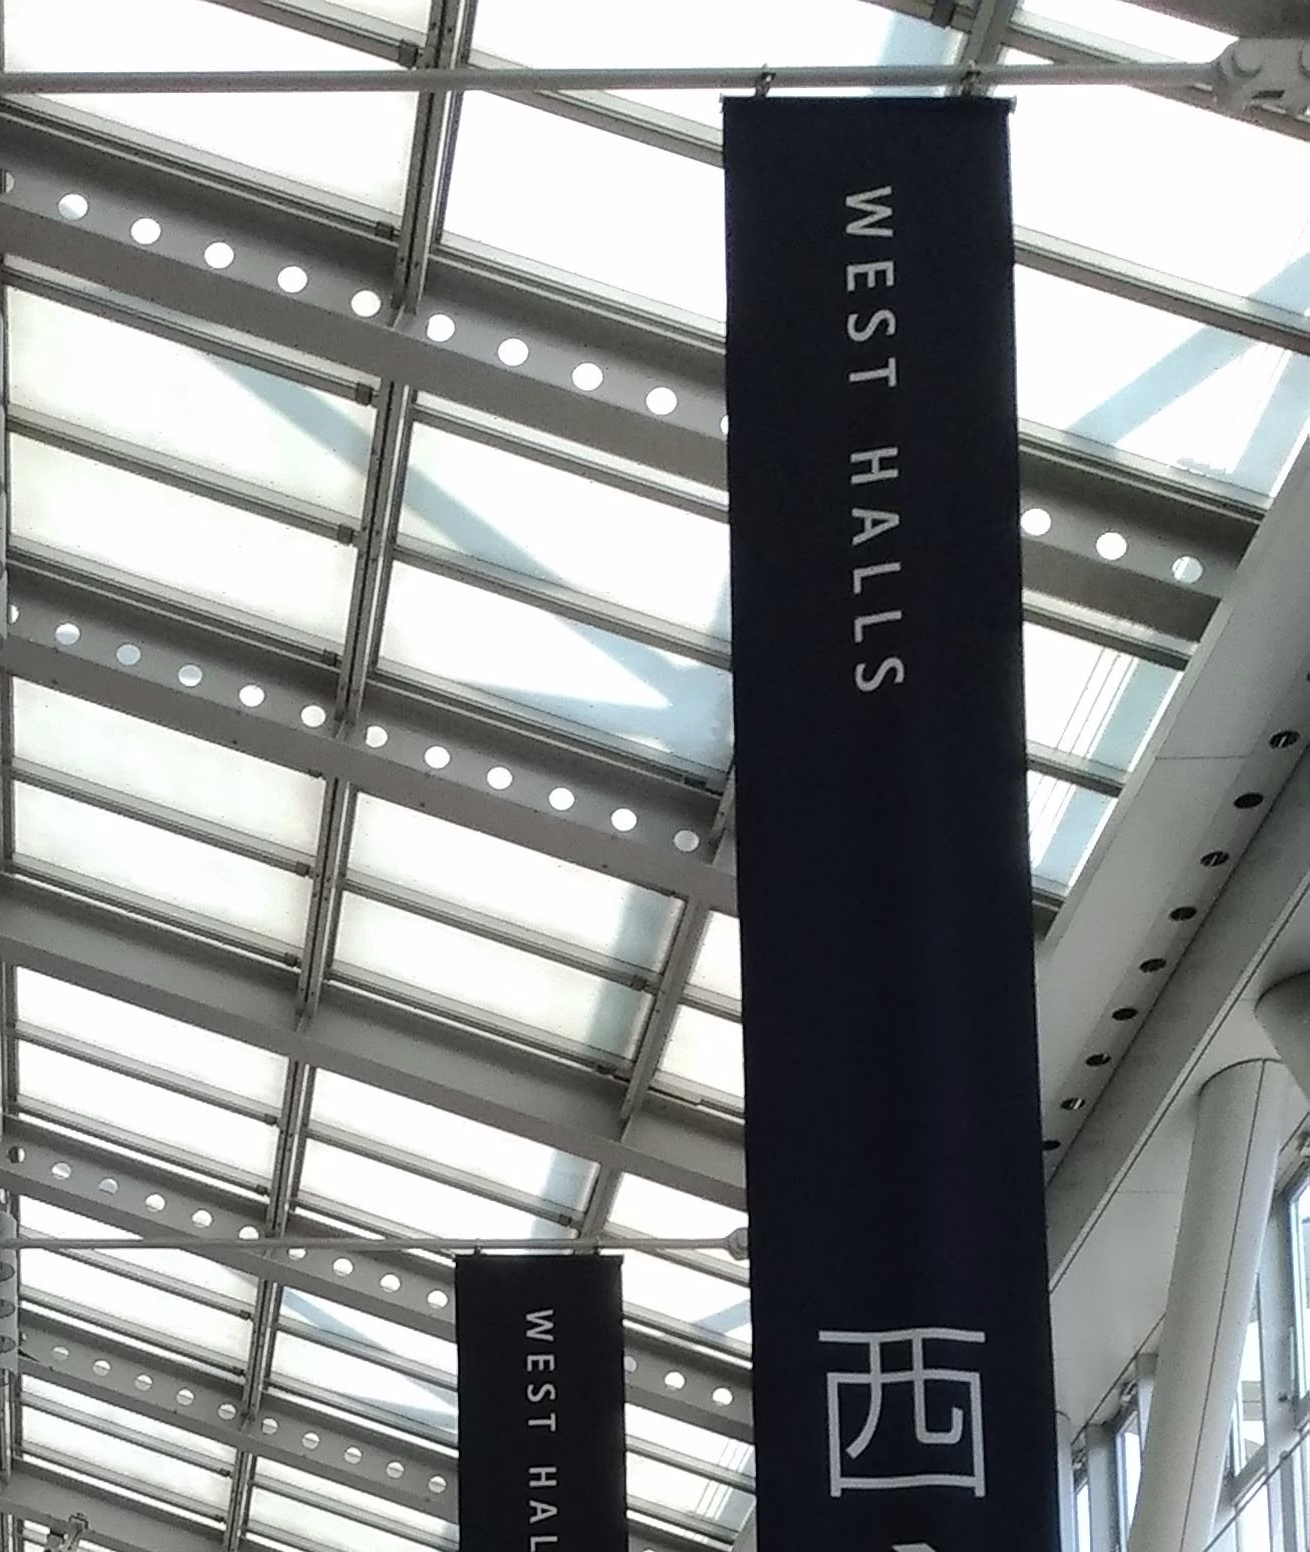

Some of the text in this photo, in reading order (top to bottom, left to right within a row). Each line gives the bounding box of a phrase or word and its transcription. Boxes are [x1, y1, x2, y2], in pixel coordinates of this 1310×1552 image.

[845, 185, 905, 693] WEST HALLS
[526, 1309, 557, 1432] WEST
[818, 1327, 986, 1498] 西
